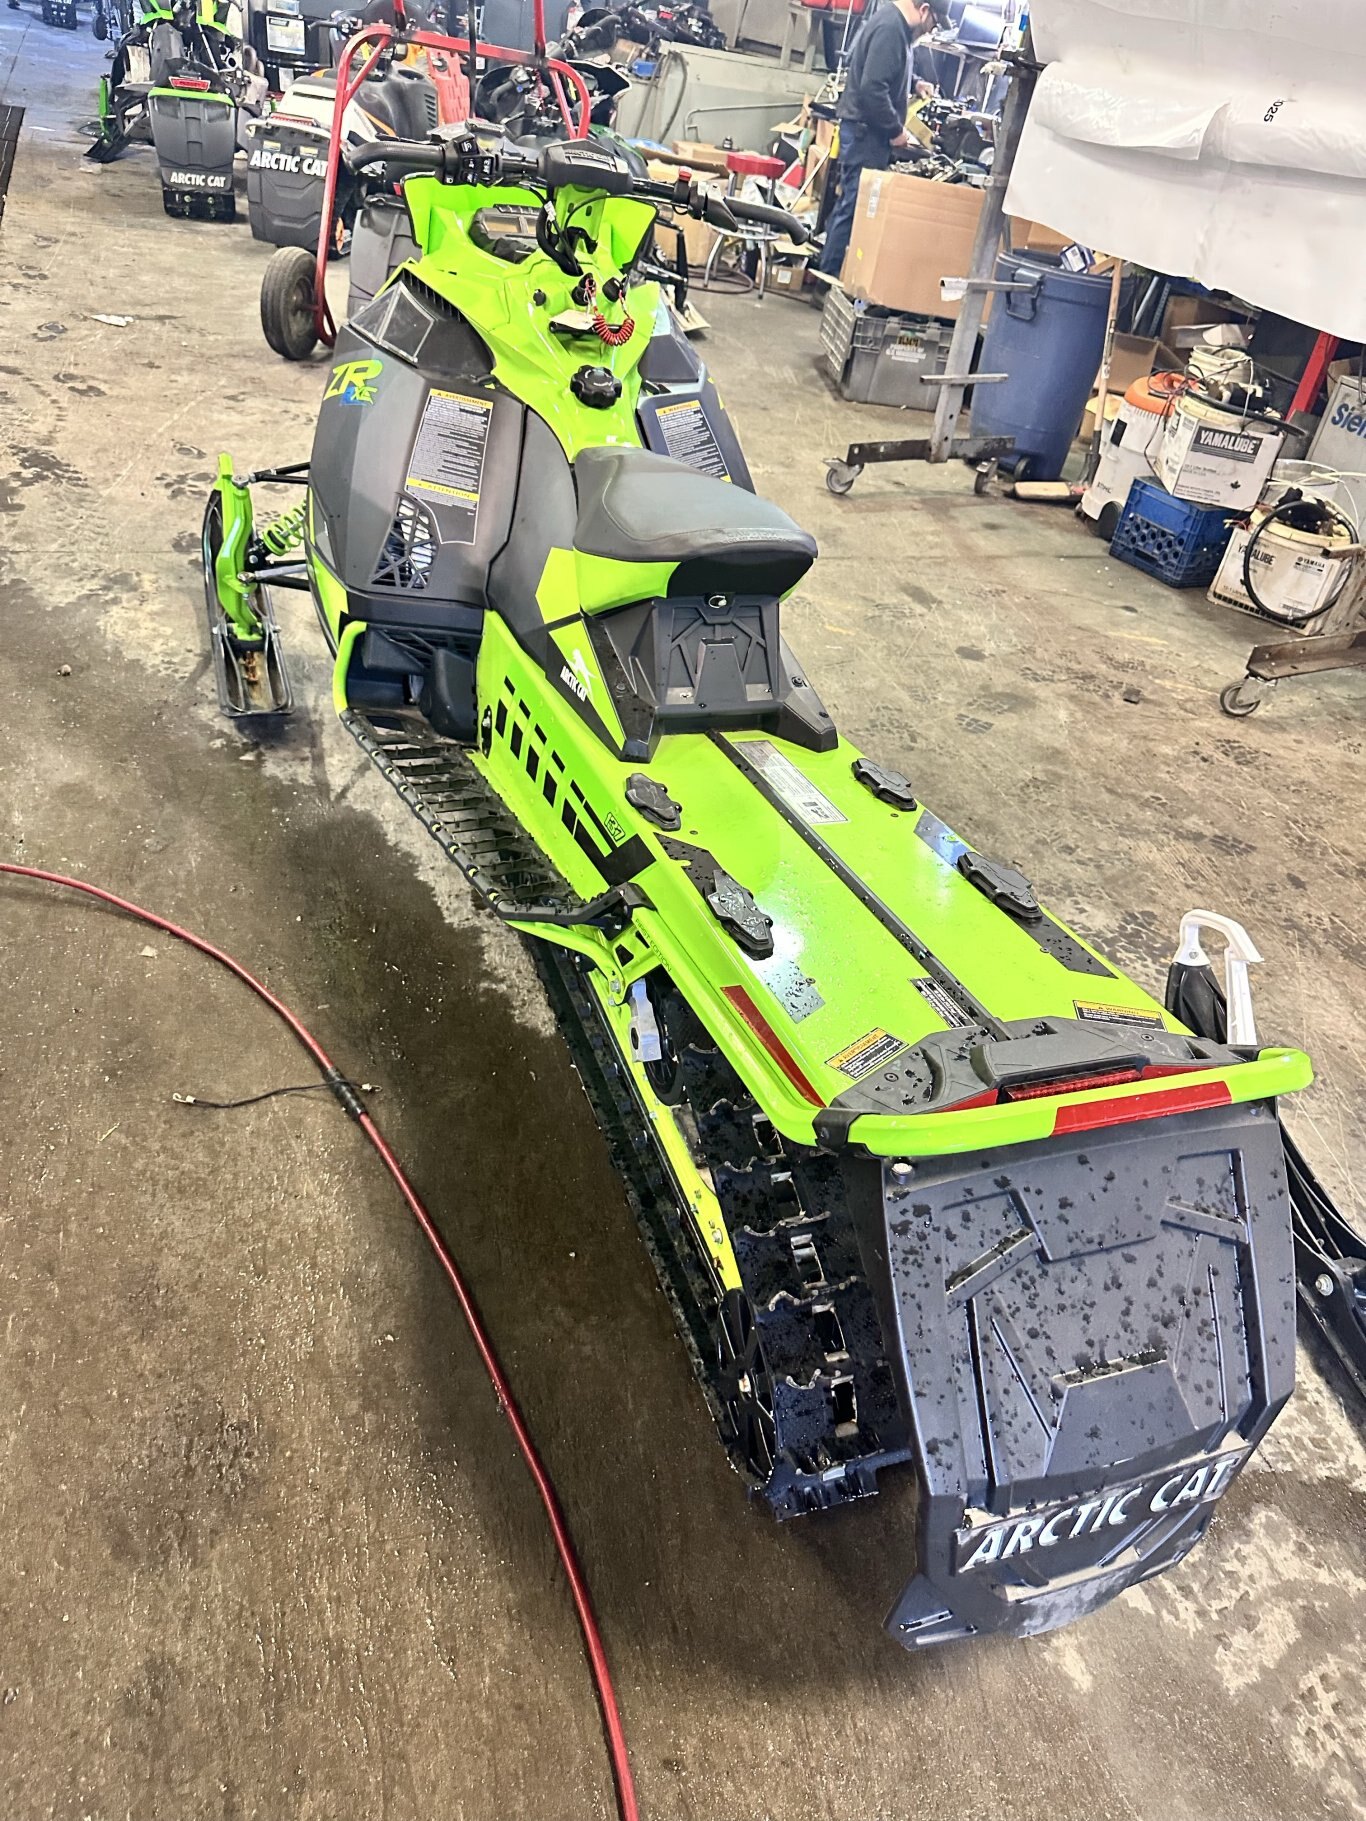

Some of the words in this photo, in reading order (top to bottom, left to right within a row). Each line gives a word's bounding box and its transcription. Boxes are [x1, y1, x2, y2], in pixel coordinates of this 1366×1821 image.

[1264, 100, 1284, 122] 025
[249, 150, 299, 173] ARCTIC
[170, 171, 205, 187] ARCTIC
[207, 175, 226, 187] CAT
[323, 359, 383, 400] ZR
[1200, 430, 1259, 454] YAMALUBE
[1239, 543, 1276, 566] YAALUBE
[1303, 558, 1325, 568] YAMAHA
[636, 918, 651, 939] FIRST
[650, 940, 672, 971] EDITION
[959, 1486, 1143, 1574] ARCTIC
[1149, 1457, 1240, 1513] CAT
